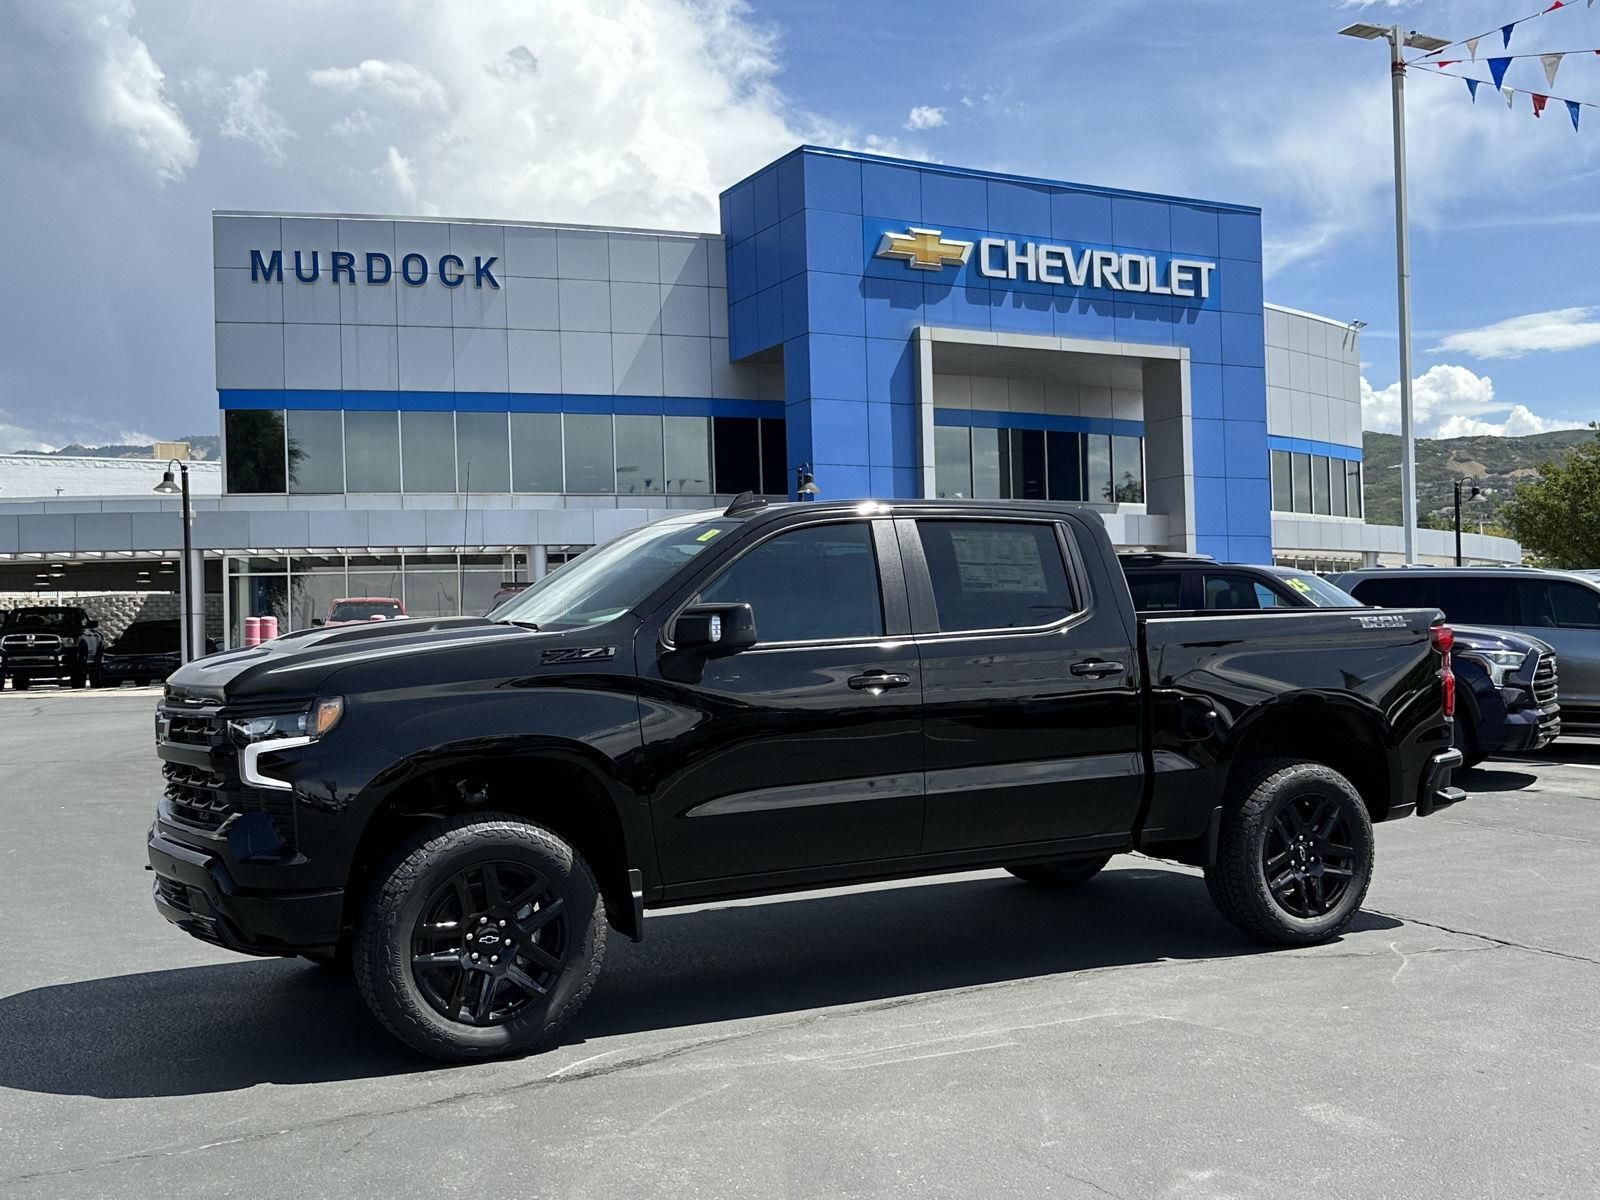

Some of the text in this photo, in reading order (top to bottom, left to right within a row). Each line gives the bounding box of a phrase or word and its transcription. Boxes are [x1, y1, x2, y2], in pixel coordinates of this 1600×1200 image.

[250, 250, 501, 289] MURDOCK
[980, 237, 1216, 298] CHEVROLET
[1351, 615, 1412, 624] TRAIL
[542, 647, 616, 664] Z71
